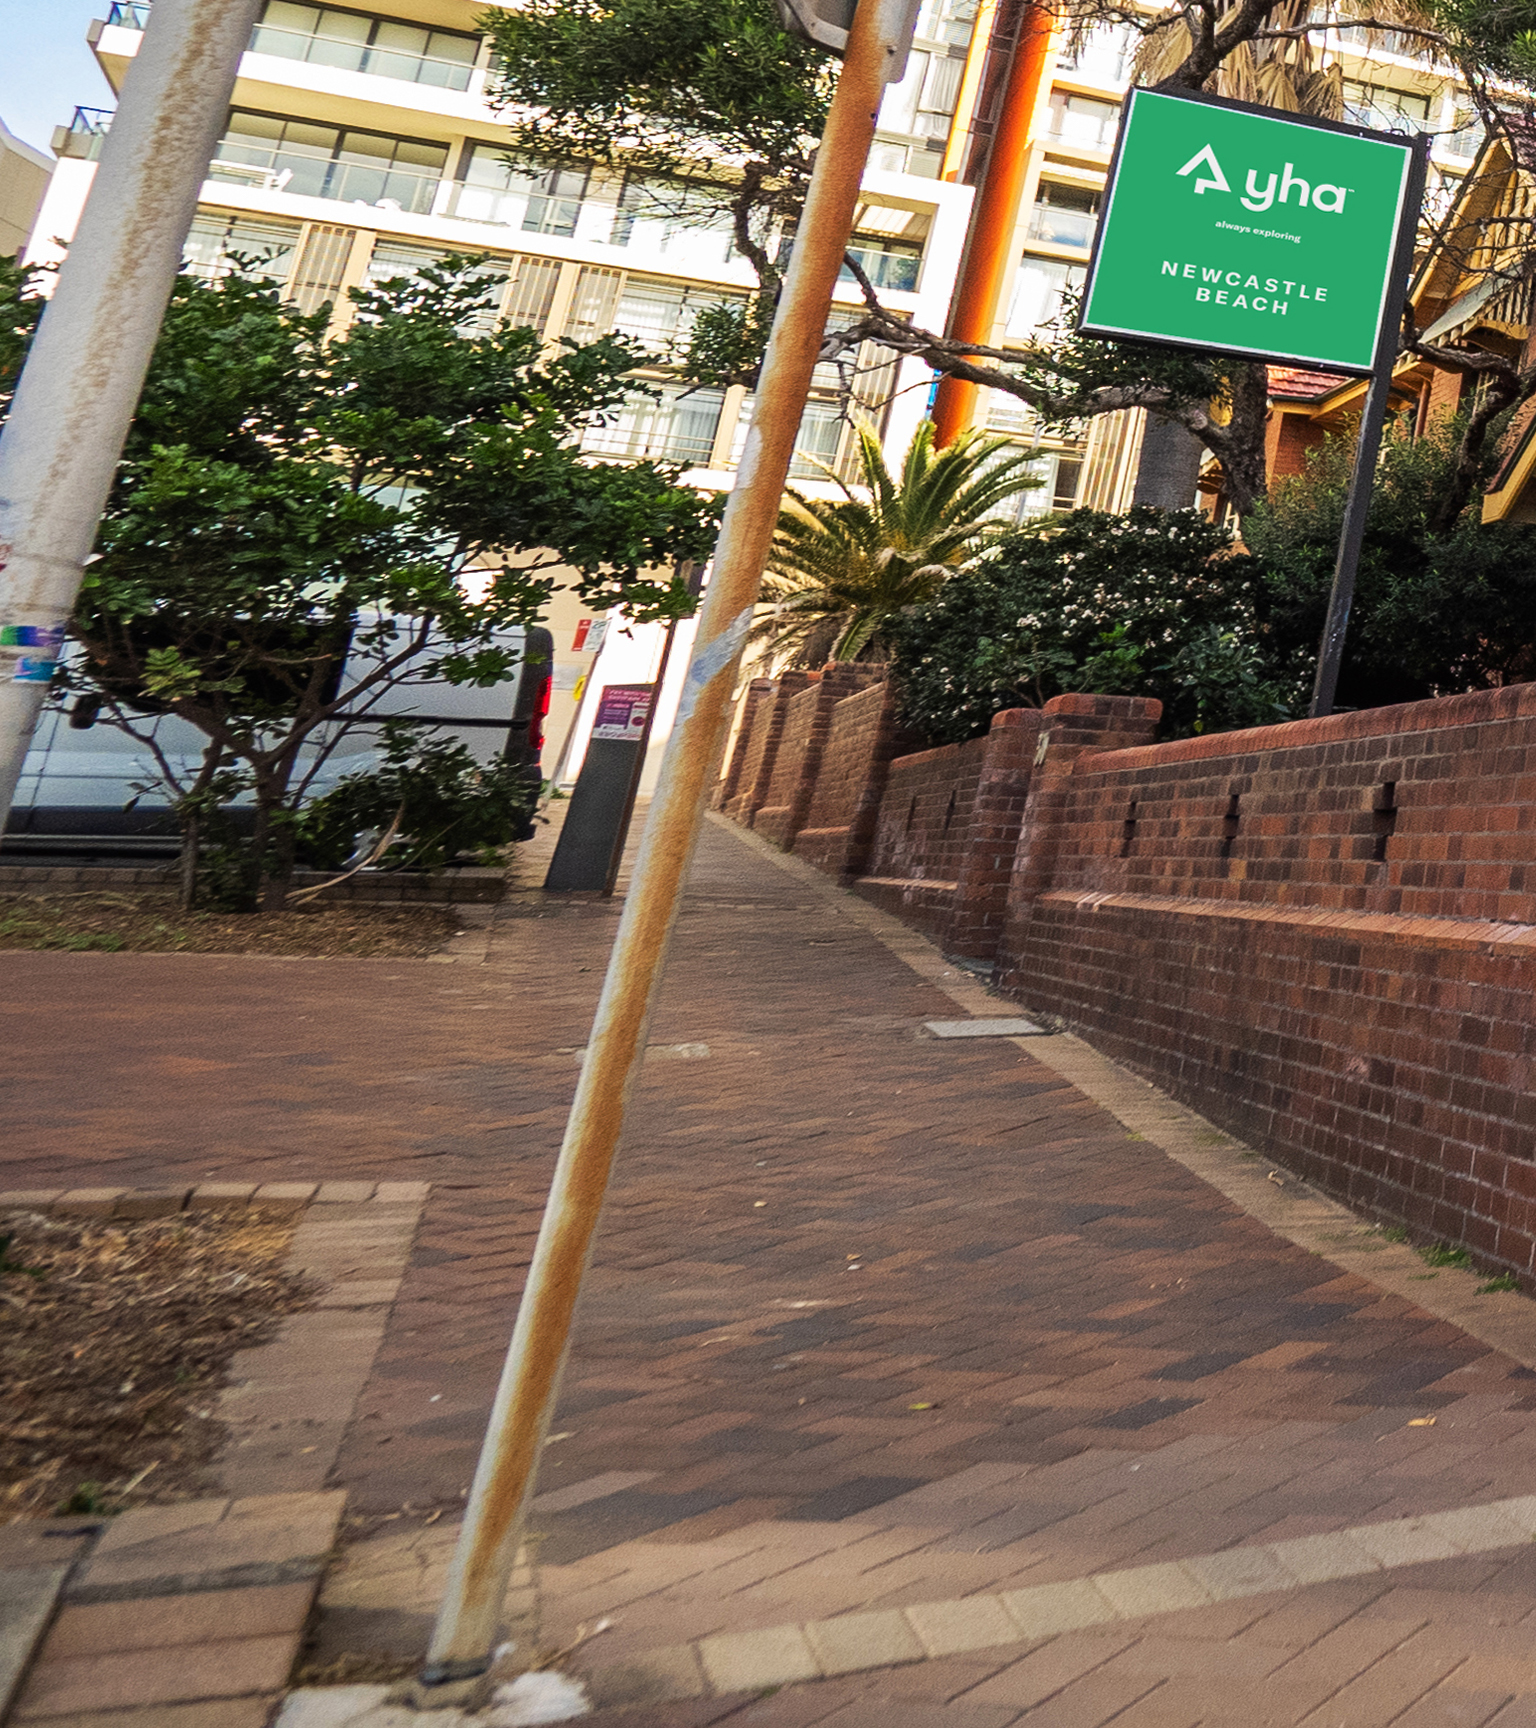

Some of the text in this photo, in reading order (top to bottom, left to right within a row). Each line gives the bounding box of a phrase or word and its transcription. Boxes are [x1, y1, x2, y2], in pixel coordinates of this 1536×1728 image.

[1215, 220, 1302, 244] always exploring
[1161, 260, 1328, 302] NEWCASTLE
[1195, 287, 1289, 315] BEACH
